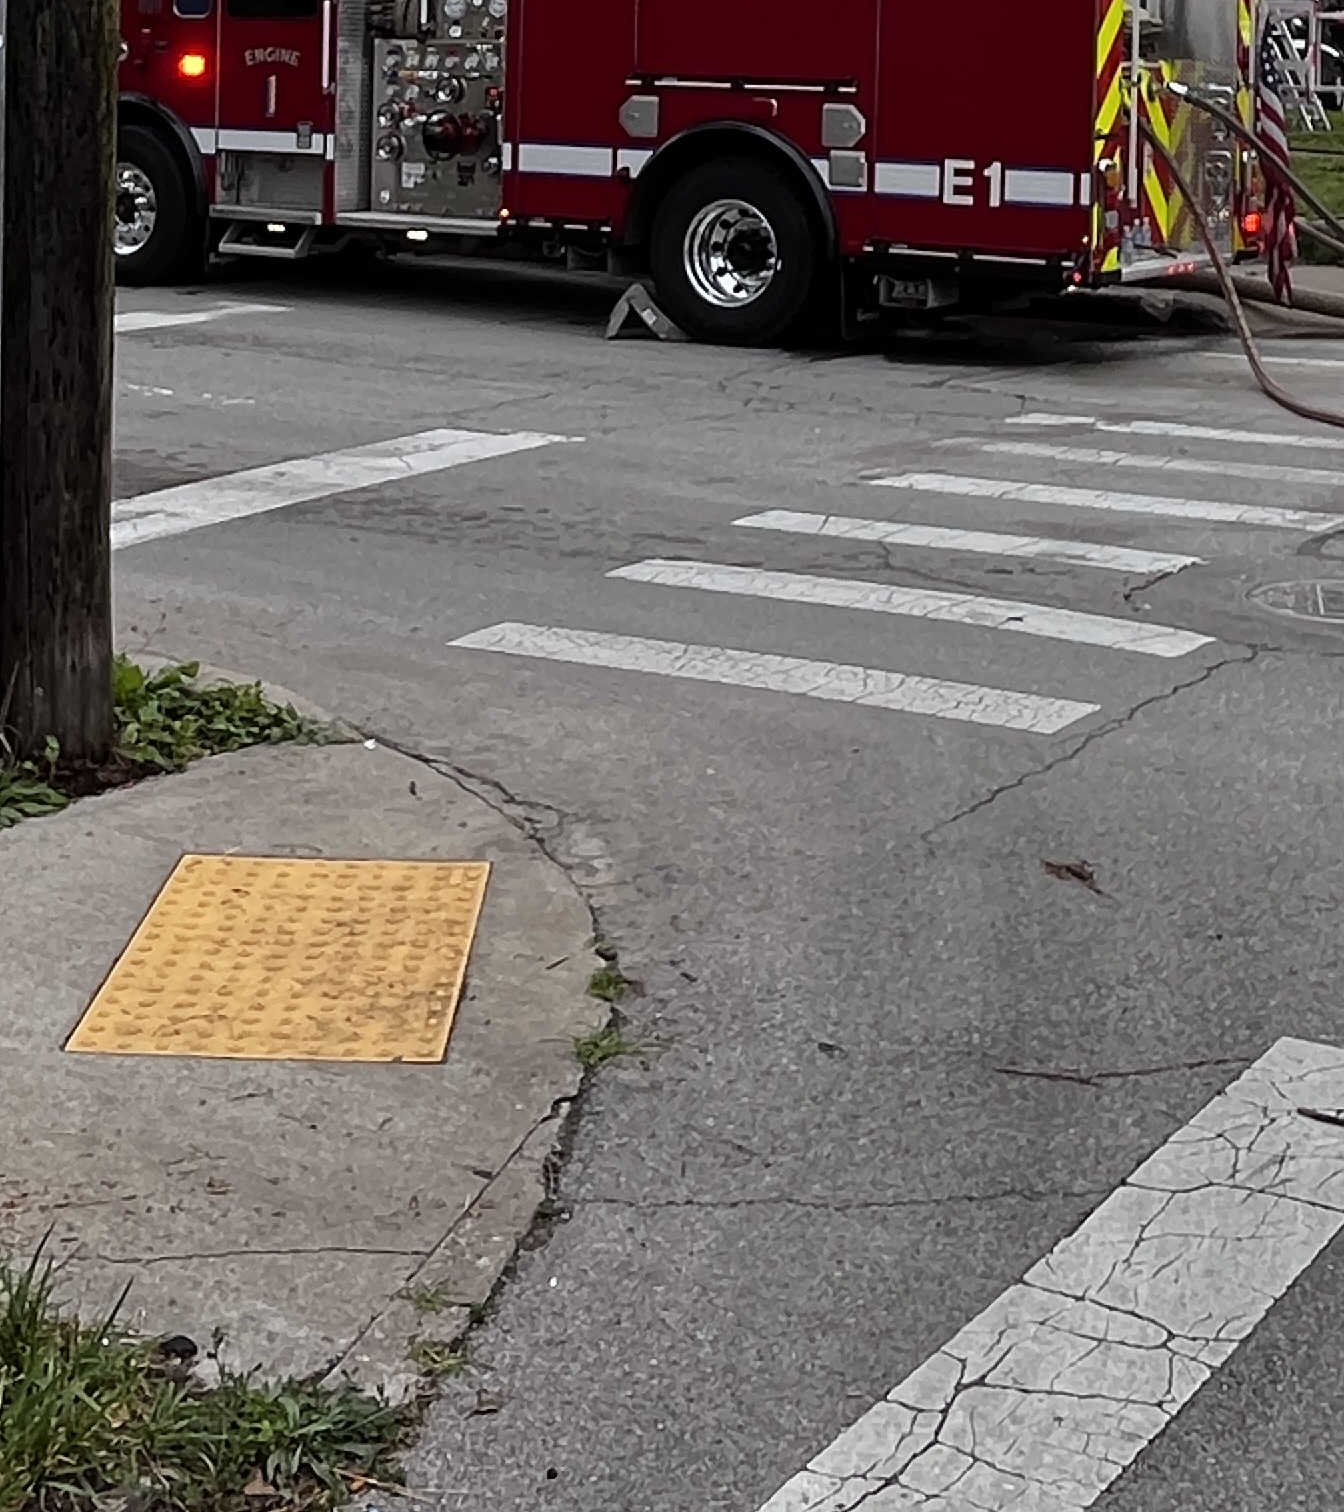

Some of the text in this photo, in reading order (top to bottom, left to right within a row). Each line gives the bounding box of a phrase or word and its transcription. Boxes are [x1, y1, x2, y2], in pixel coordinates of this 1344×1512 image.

[244, 47, 301, 68] ENGINE
[265, 74, 277, 118] 1
[942, 158, 1002, 208] E1
